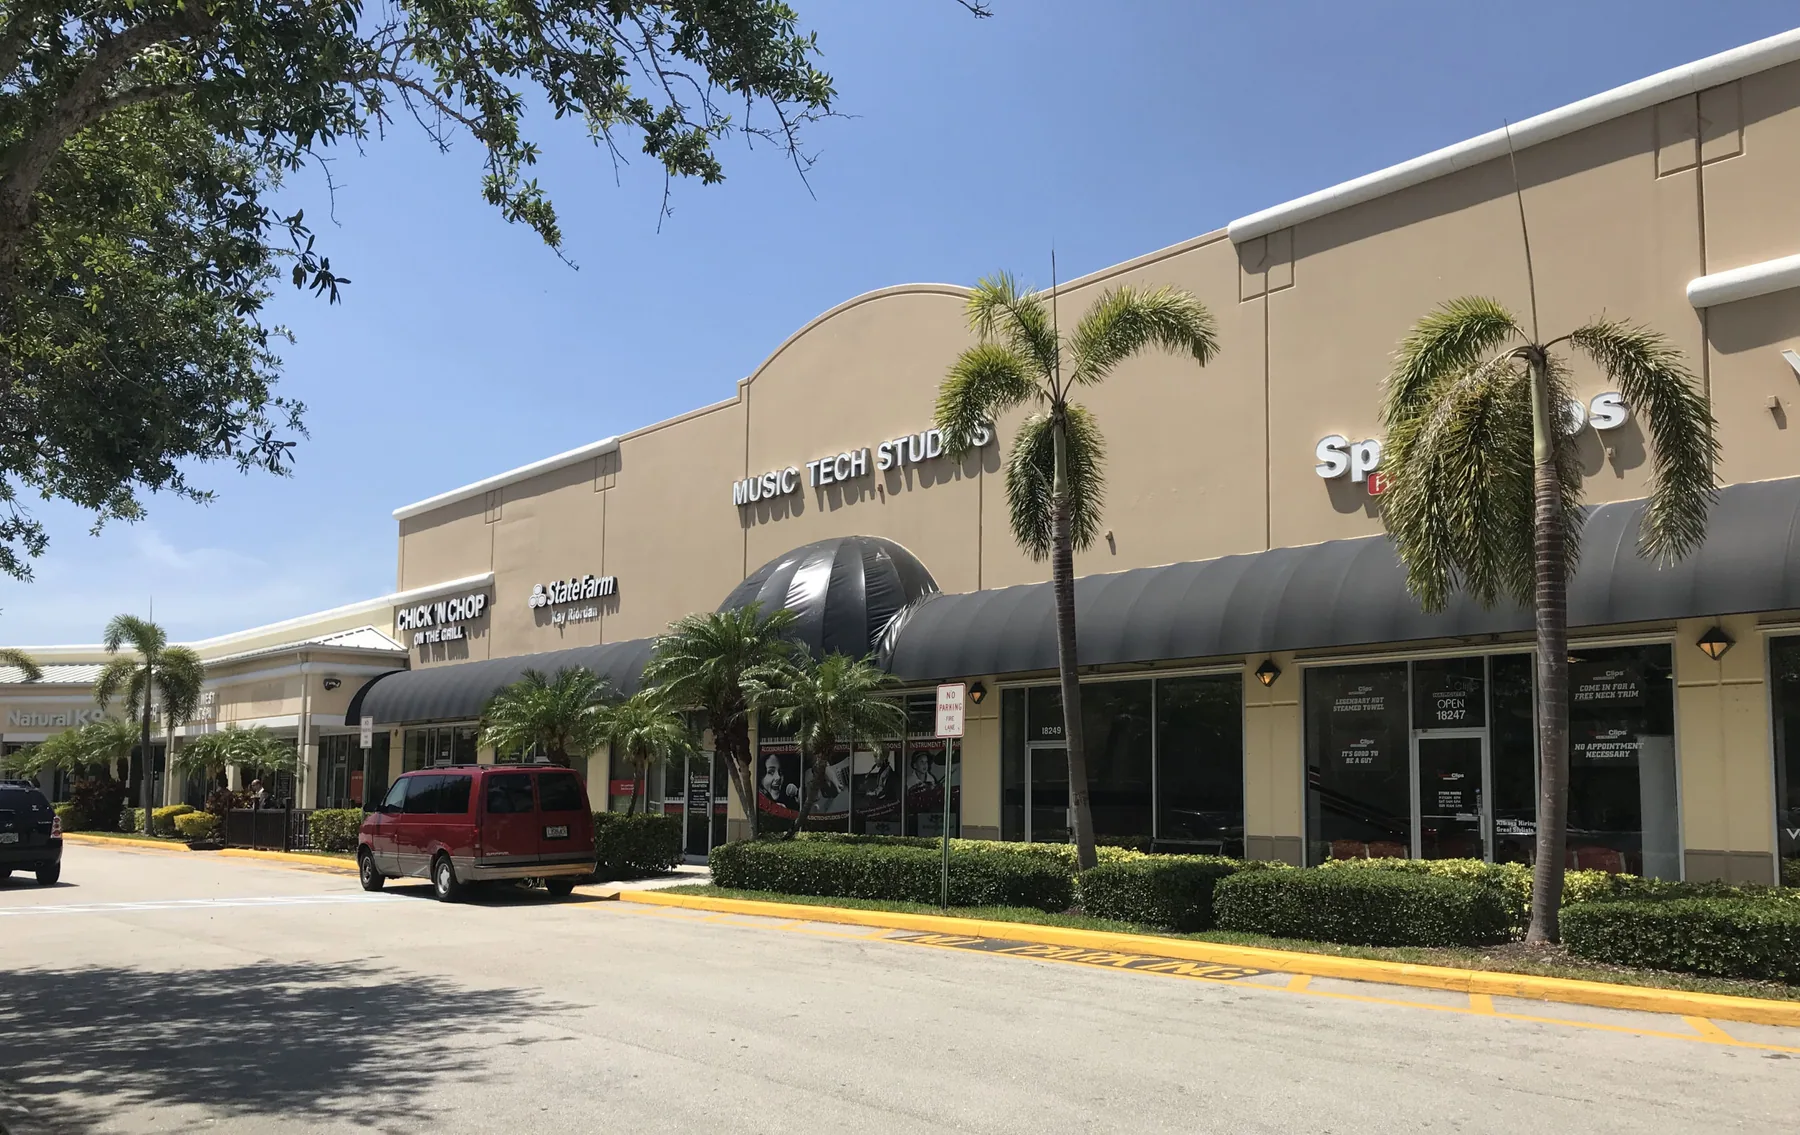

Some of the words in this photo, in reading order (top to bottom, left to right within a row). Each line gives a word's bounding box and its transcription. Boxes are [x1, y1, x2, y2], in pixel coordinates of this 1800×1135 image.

[733, 466, 798, 505] MUSIC
[806, 447, 870, 487] TECH
[877, 423, 991, 471] STUDS
[397, 603, 433, 631] CHICK
[447, 594, 485, 622] CHOP
[551, 610, 566, 625] Kay
[567, 605, 599, 621] Riordan
[414, 631, 425, 646] ON
[425, 629, 440, 643] THE
[441, 625, 464, 642] GRILL
[1579, 684, 1601, 692] COME
[1602, 683, 1611, 691] IN
[1612, 682, 1628, 690] FOR
[1629, 682, 1636, 690] A
[945, 691, 956, 699] NO
[1574, 692, 1594, 700] FREE
[1595, 691, 1616, 699] NECK
[1617, 690, 1639, 698] TRIM
[939, 703, 963, 711] PARKING
[1333, 704, 1362, 712] STEAMED
[1437, 698, 1465, 709] OPEN
[7, 709, 70, 726] Natural
[1436, 709, 1466, 720] 18247
[1041, 726, 1062, 735] 18249
[1586, 742, 1645, 751] APPOINTMENT
[1585, 750, 1630, 758] NECESSARY
[896, 934, 985, 946] NO
[994, 945, 1260, 979] PARKING
